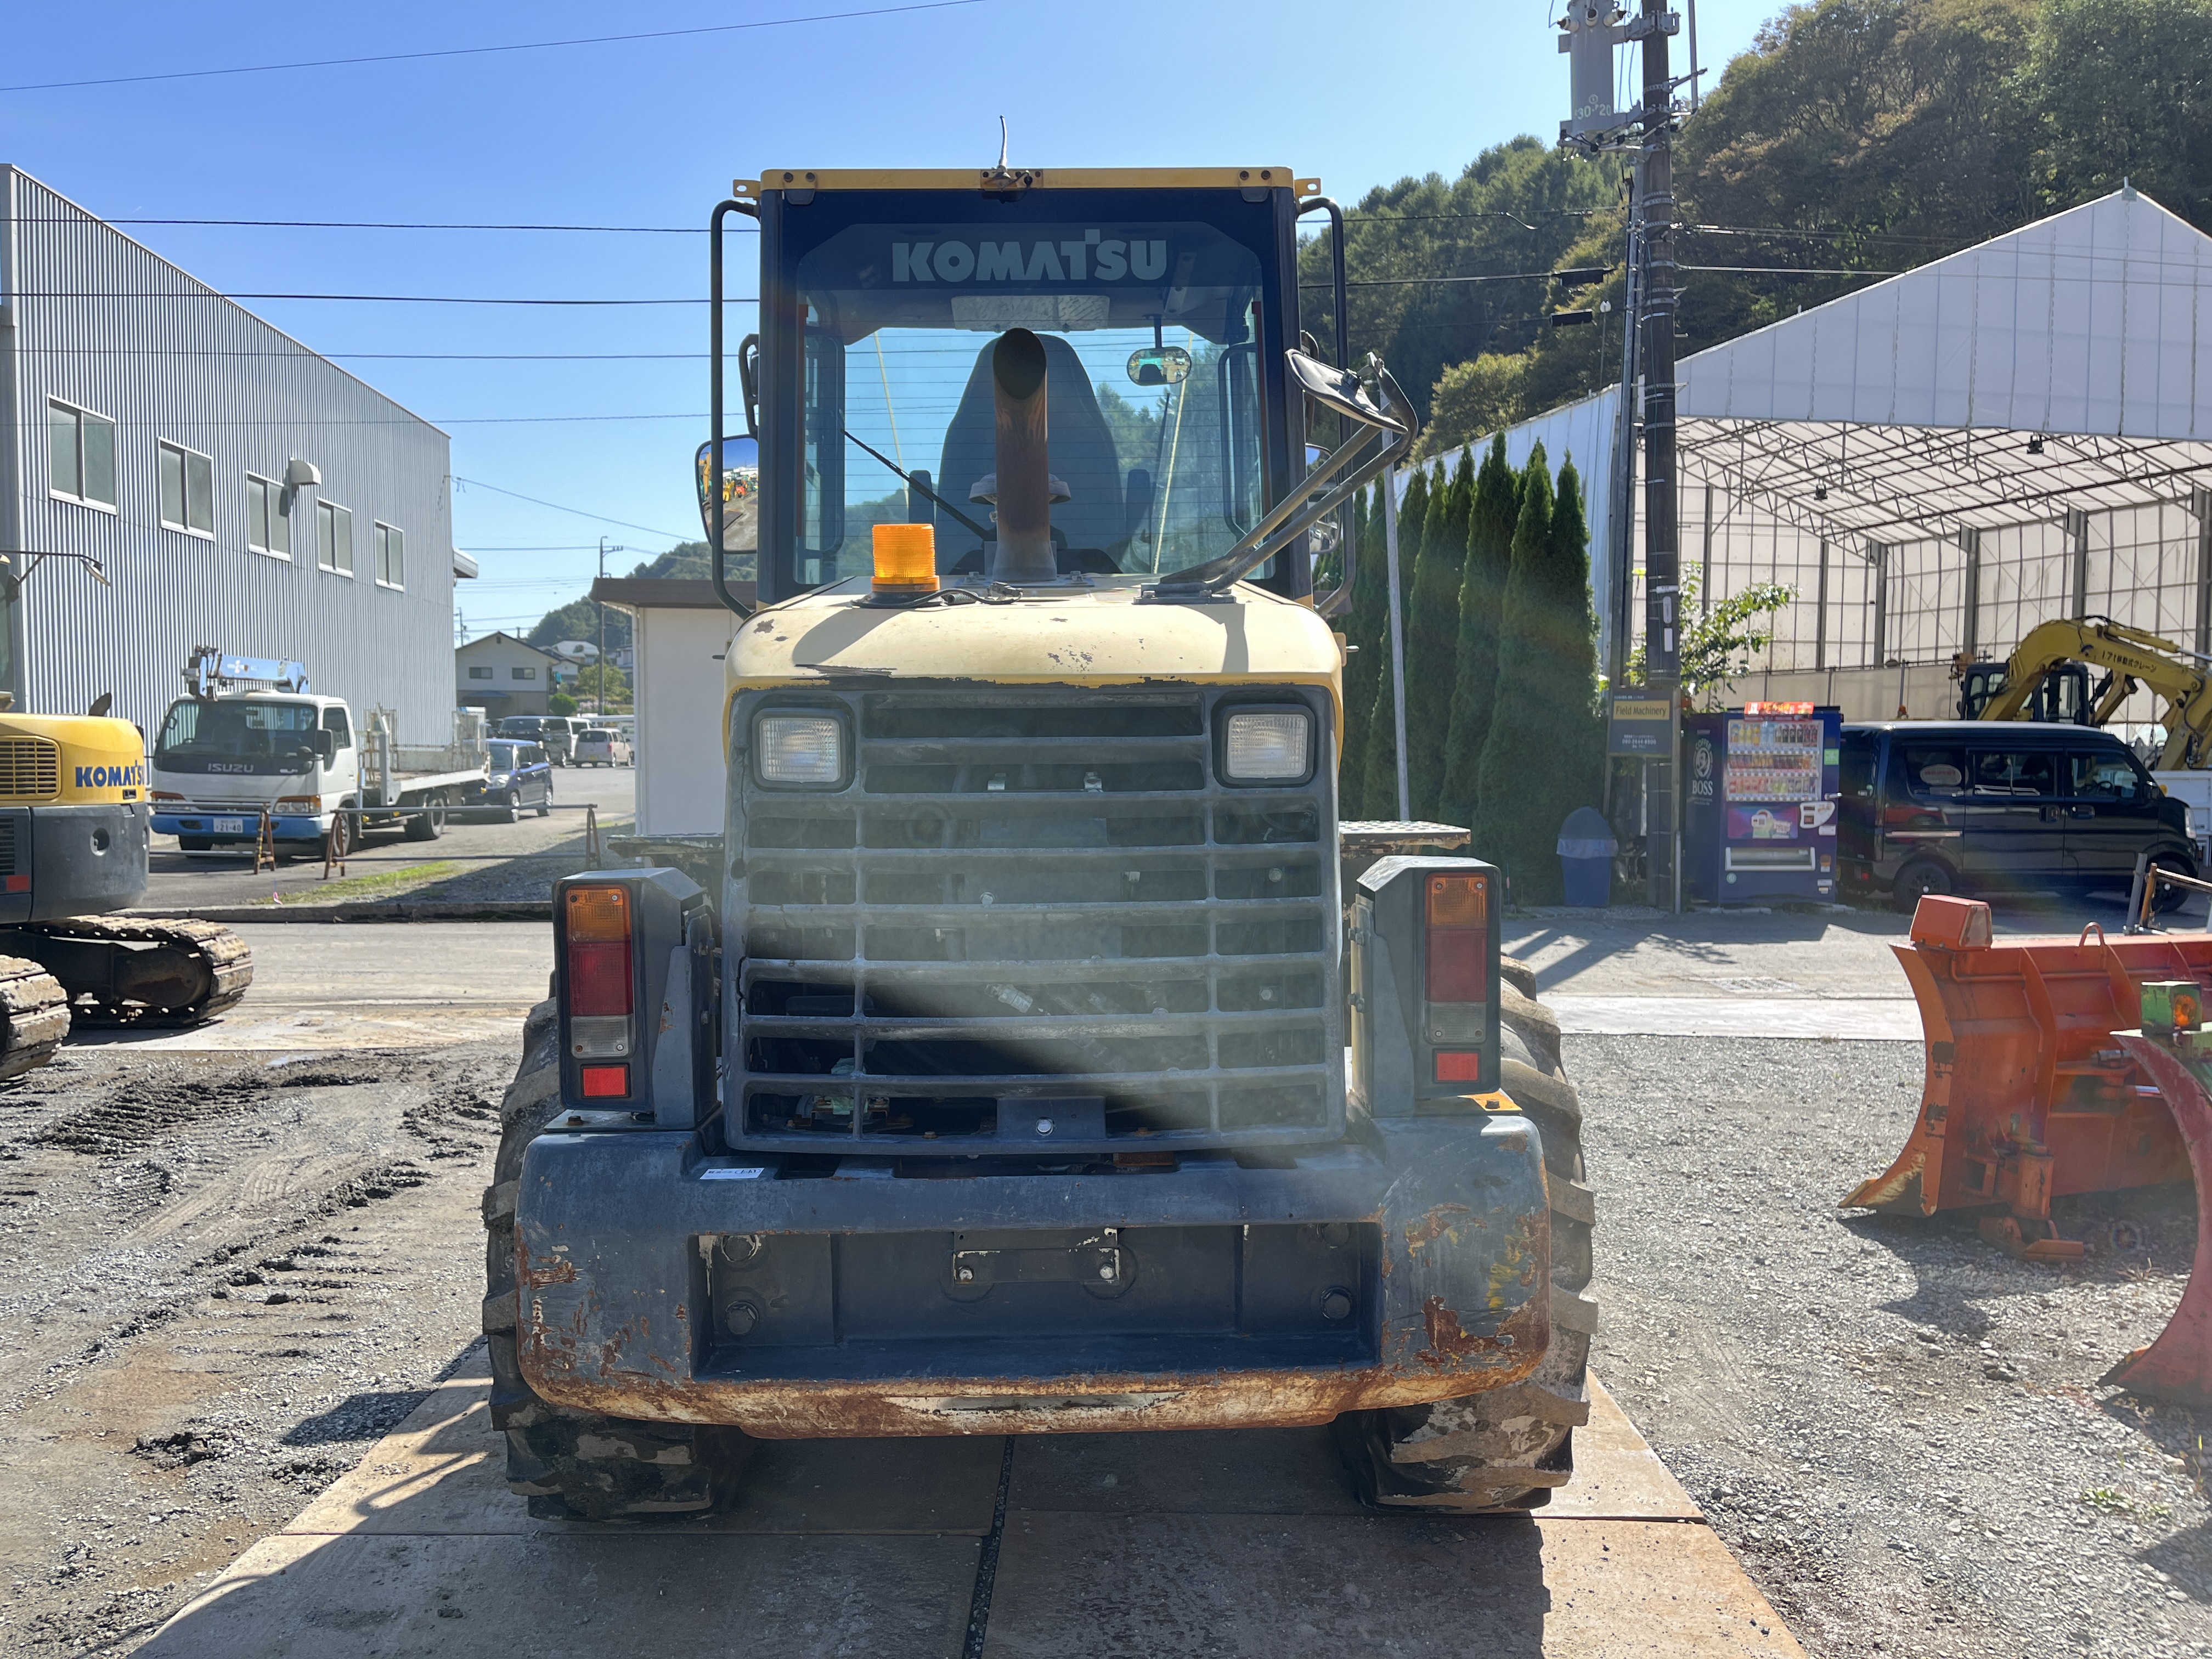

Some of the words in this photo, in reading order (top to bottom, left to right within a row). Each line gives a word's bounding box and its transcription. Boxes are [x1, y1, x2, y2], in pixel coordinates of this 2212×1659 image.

[892, 229, 1167, 282] KOMATSU
[1616, 705, 1632, 715] Field
[1633, 705, 1667, 718] Machinery
[207, 763, 254, 773] ISUZU
[1692, 780, 1713, 795] BOSS
